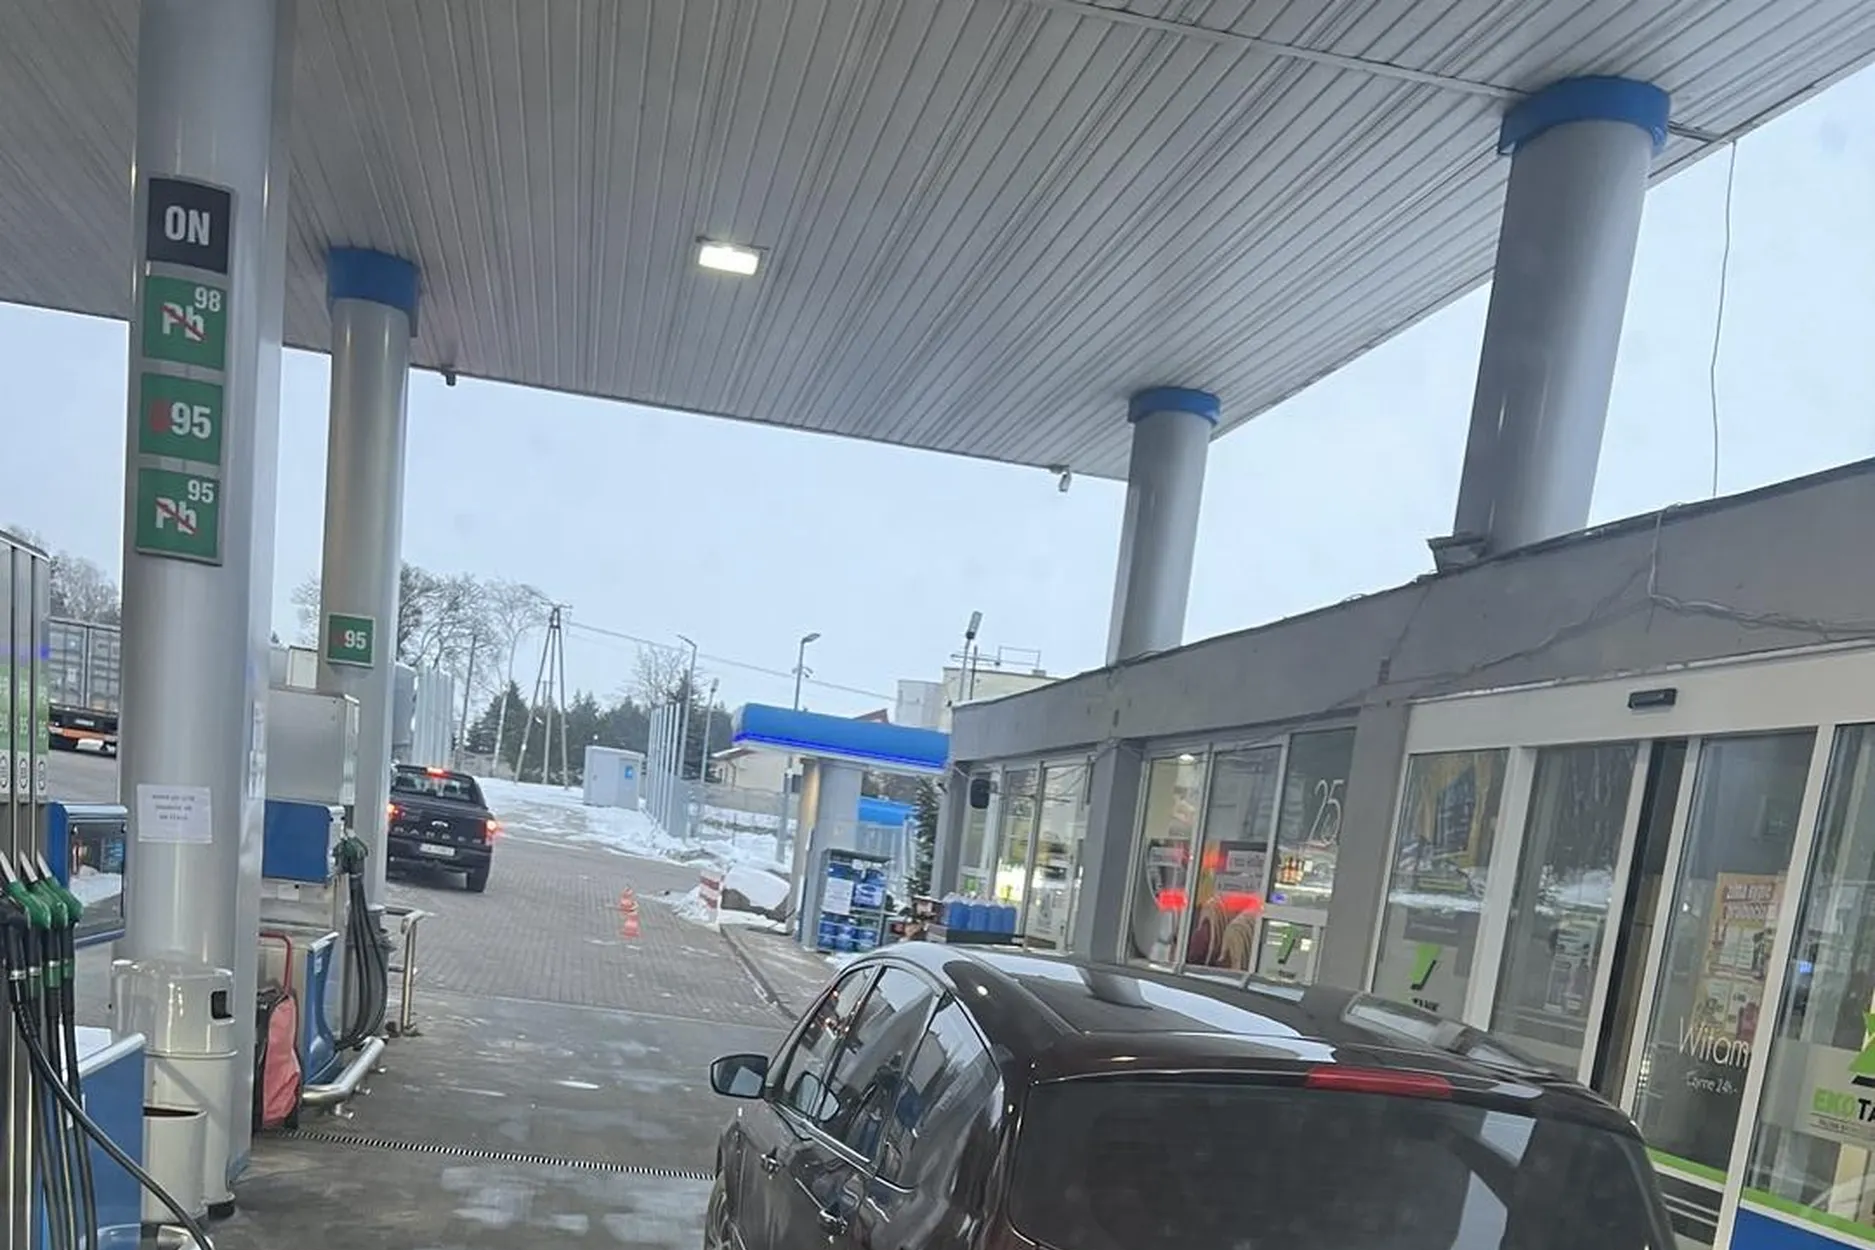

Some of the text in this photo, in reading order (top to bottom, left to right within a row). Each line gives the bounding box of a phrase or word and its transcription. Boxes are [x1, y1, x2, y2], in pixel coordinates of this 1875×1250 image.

[164, 206, 211, 246] ON
[194, 287, 221, 312] 98
[162, 302, 205, 341] Pb
[171, 401, 212, 439] 95
[187, 480, 214, 504] 95
[344, 630, 367, 650] 95
[1679, 1016, 1749, 1068] Witam
